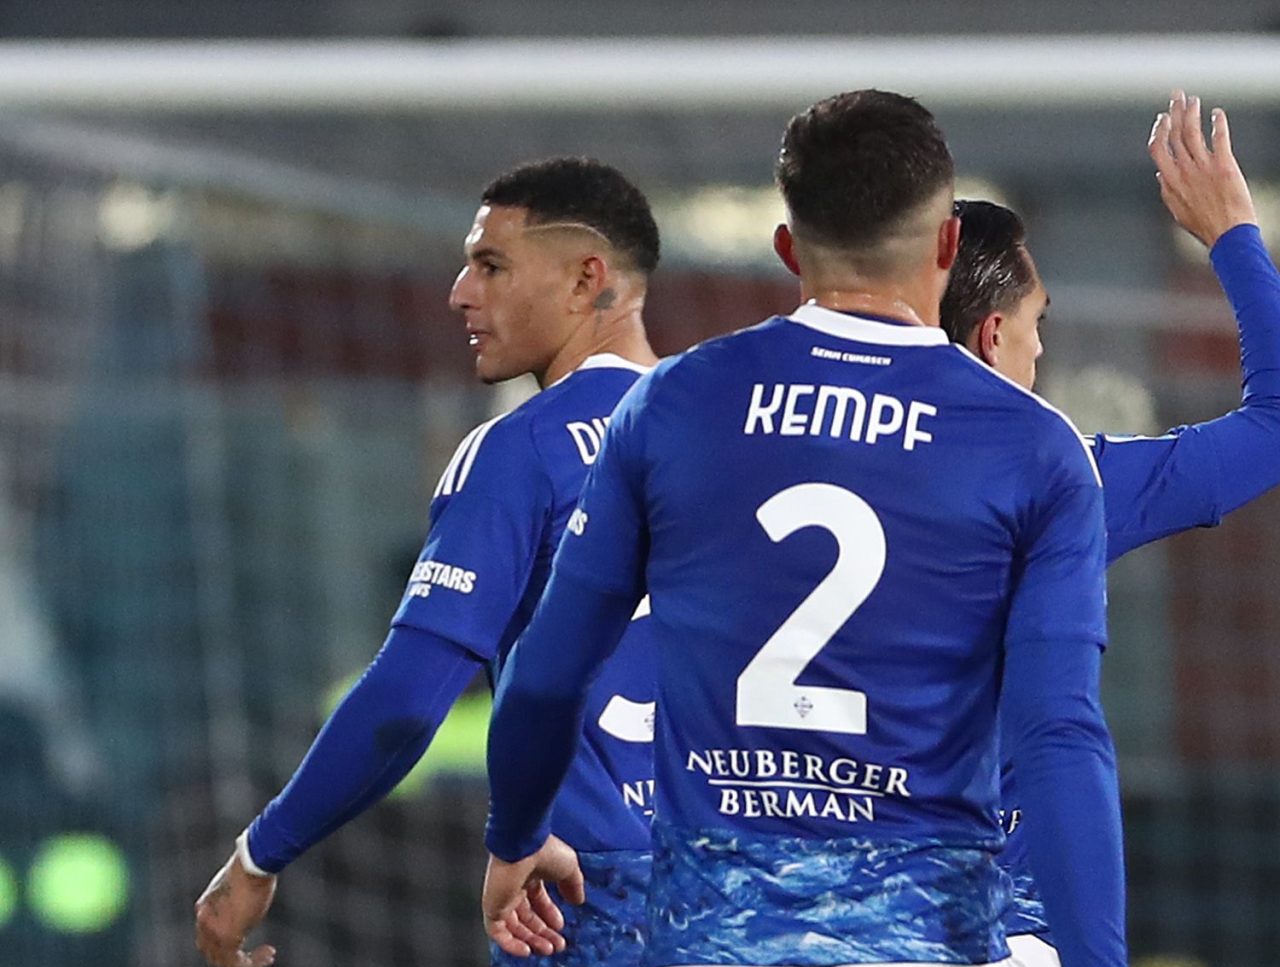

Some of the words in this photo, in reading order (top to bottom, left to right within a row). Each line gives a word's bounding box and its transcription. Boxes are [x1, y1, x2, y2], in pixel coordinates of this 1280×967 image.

[744, 384, 937, 452] KEMPF
[736, 483, 887, 735] 2
[686, 750, 912, 797] NEUBERGER
[719, 788, 874, 822] BERMAN
